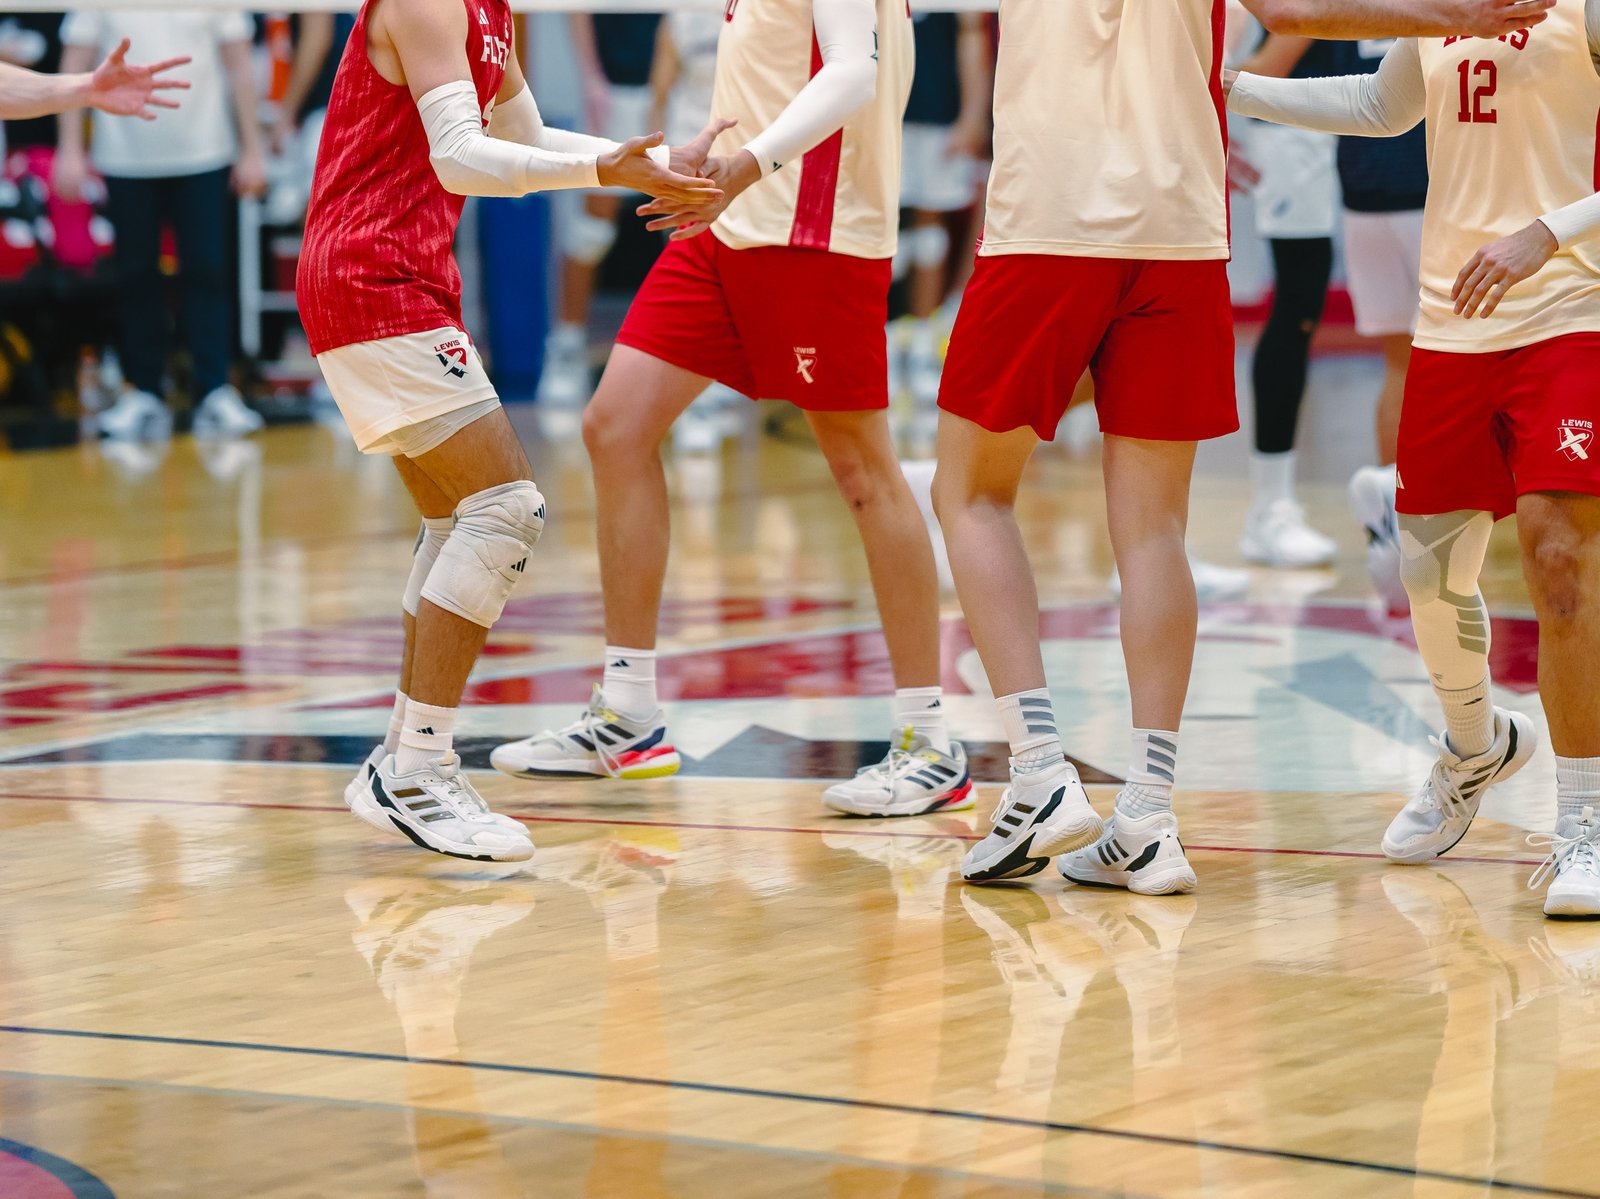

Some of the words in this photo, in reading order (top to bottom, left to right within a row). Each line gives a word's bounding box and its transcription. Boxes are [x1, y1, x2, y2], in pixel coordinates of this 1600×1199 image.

[1457, 59, 1498, 124] 12
[434, 339, 460, 352] LEWIS
[1561, 418, 1593, 429] LEWIS
